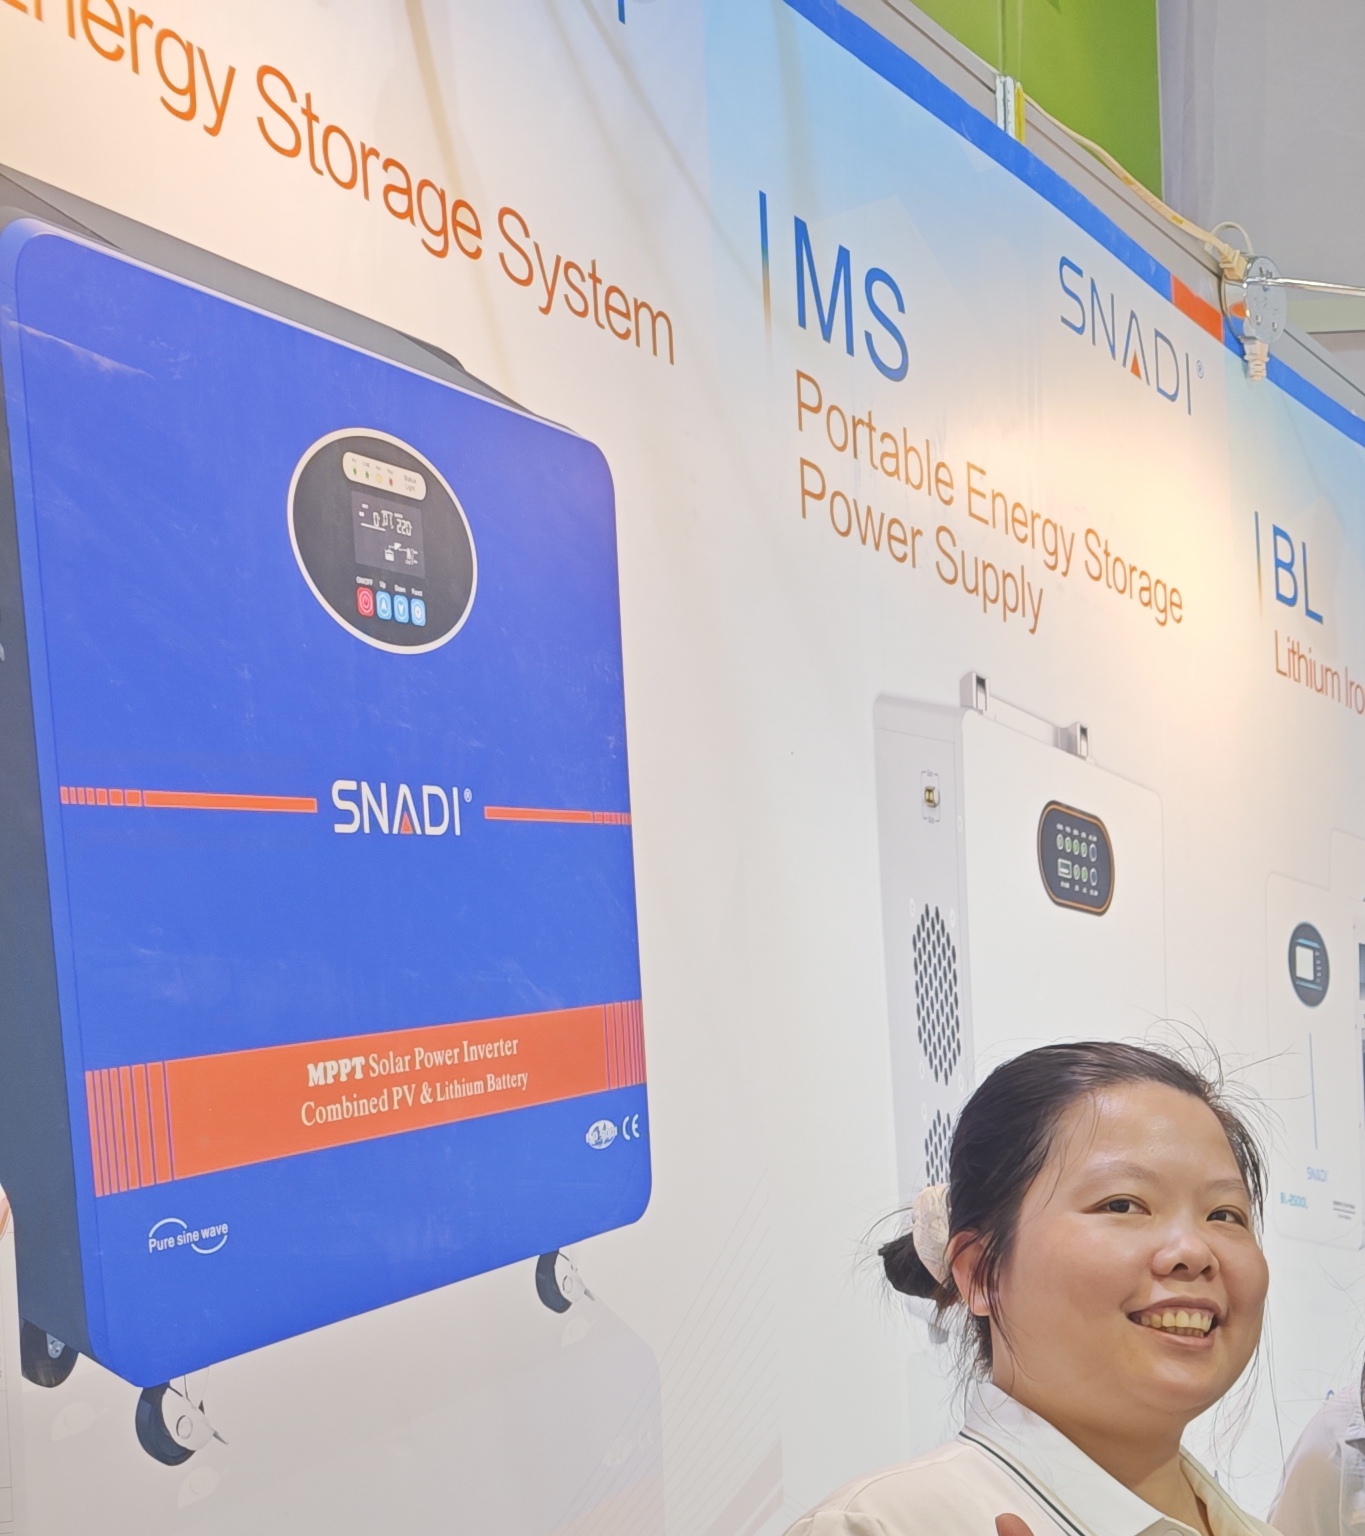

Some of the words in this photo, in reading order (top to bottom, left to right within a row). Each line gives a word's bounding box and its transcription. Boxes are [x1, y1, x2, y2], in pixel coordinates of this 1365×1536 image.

[0, 0, 237, 137] ergy
[256, 64, 482, 259] Storage
[498, 207, 674, 366] System
[794, 215, 909, 383] MS
[796, 369, 955, 507] Portable
[966, 461, 1075, 579] Energy
[1084, 528, 1183, 626] Storage
[800, 457, 923, 570] Power
[935, 525, 1044, 635] Supply
[1272, 524, 1323, 625] BL
[1274, 629, 1341, 703] Lithium
[301, 1088, 389, 1127] Combined
[392, 1084, 416, 1110] PV
[420, 1081, 433, 1104] &
[435, 1077, 484, 1102] Lithium
[486, 1072, 528, 1093] Battery
[307, 1056, 365, 1087] MPPT
[368, 1050, 411, 1078] Solar
[414, 1046, 459, 1071] Power
[462, 1038, 518, 1063] Inverter
[148, 1236, 174, 1253] Pure
[176, 1227, 199, 1249] sine
[200, 1222, 229, 1243] wave
